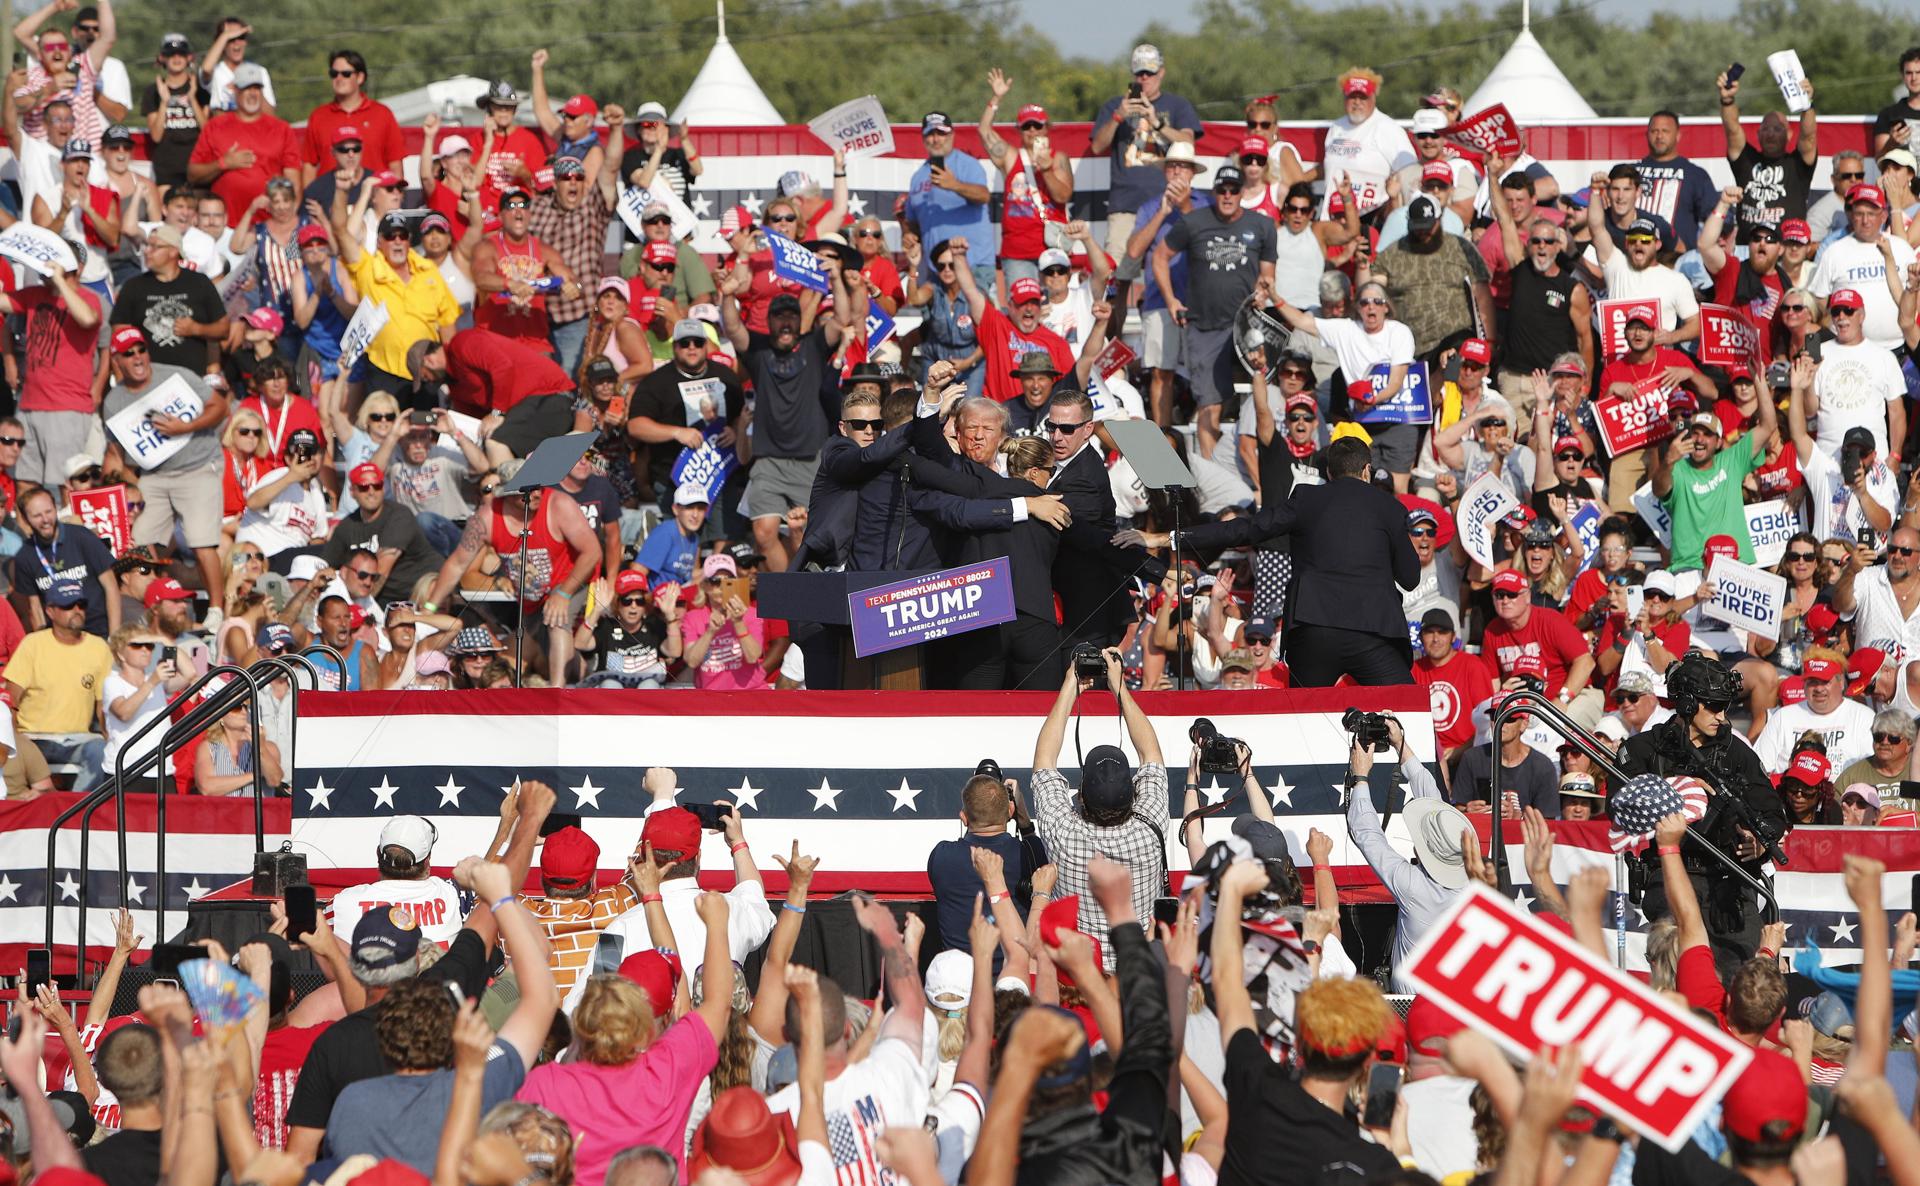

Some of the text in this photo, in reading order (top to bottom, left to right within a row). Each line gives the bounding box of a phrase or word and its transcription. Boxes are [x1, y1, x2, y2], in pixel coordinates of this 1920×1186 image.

[834, 117, 877, 141] YOU'RE
[844, 132, 884, 152] FIRED!
[783, 248, 819, 272] 2024
[1613, 308, 1630, 360] UMP
[131, 395, 188, 439] YORE
[1607, 385, 1674, 422] TRUMP
[1622, 402, 1670, 432] 2024
[1467, 490, 1494, 544] YOU'RE
[1476, 493, 1506, 558] FIRED!
[868, 570, 993, 607] TEXT PENNSYLVANIA TO 88022
[1719, 577, 1772, 608] YOU'RE
[880, 584, 984, 628] TRUMP
[1711, 592, 1774, 625] FIRED!
[888, 610, 981, 639] MAKE AMERICA GREAT AGAIN!
[924, 627, 948, 641] 2024
[1792, 730, 1855, 750] TMP
[1437, 904, 1719, 1107] TRUMP
